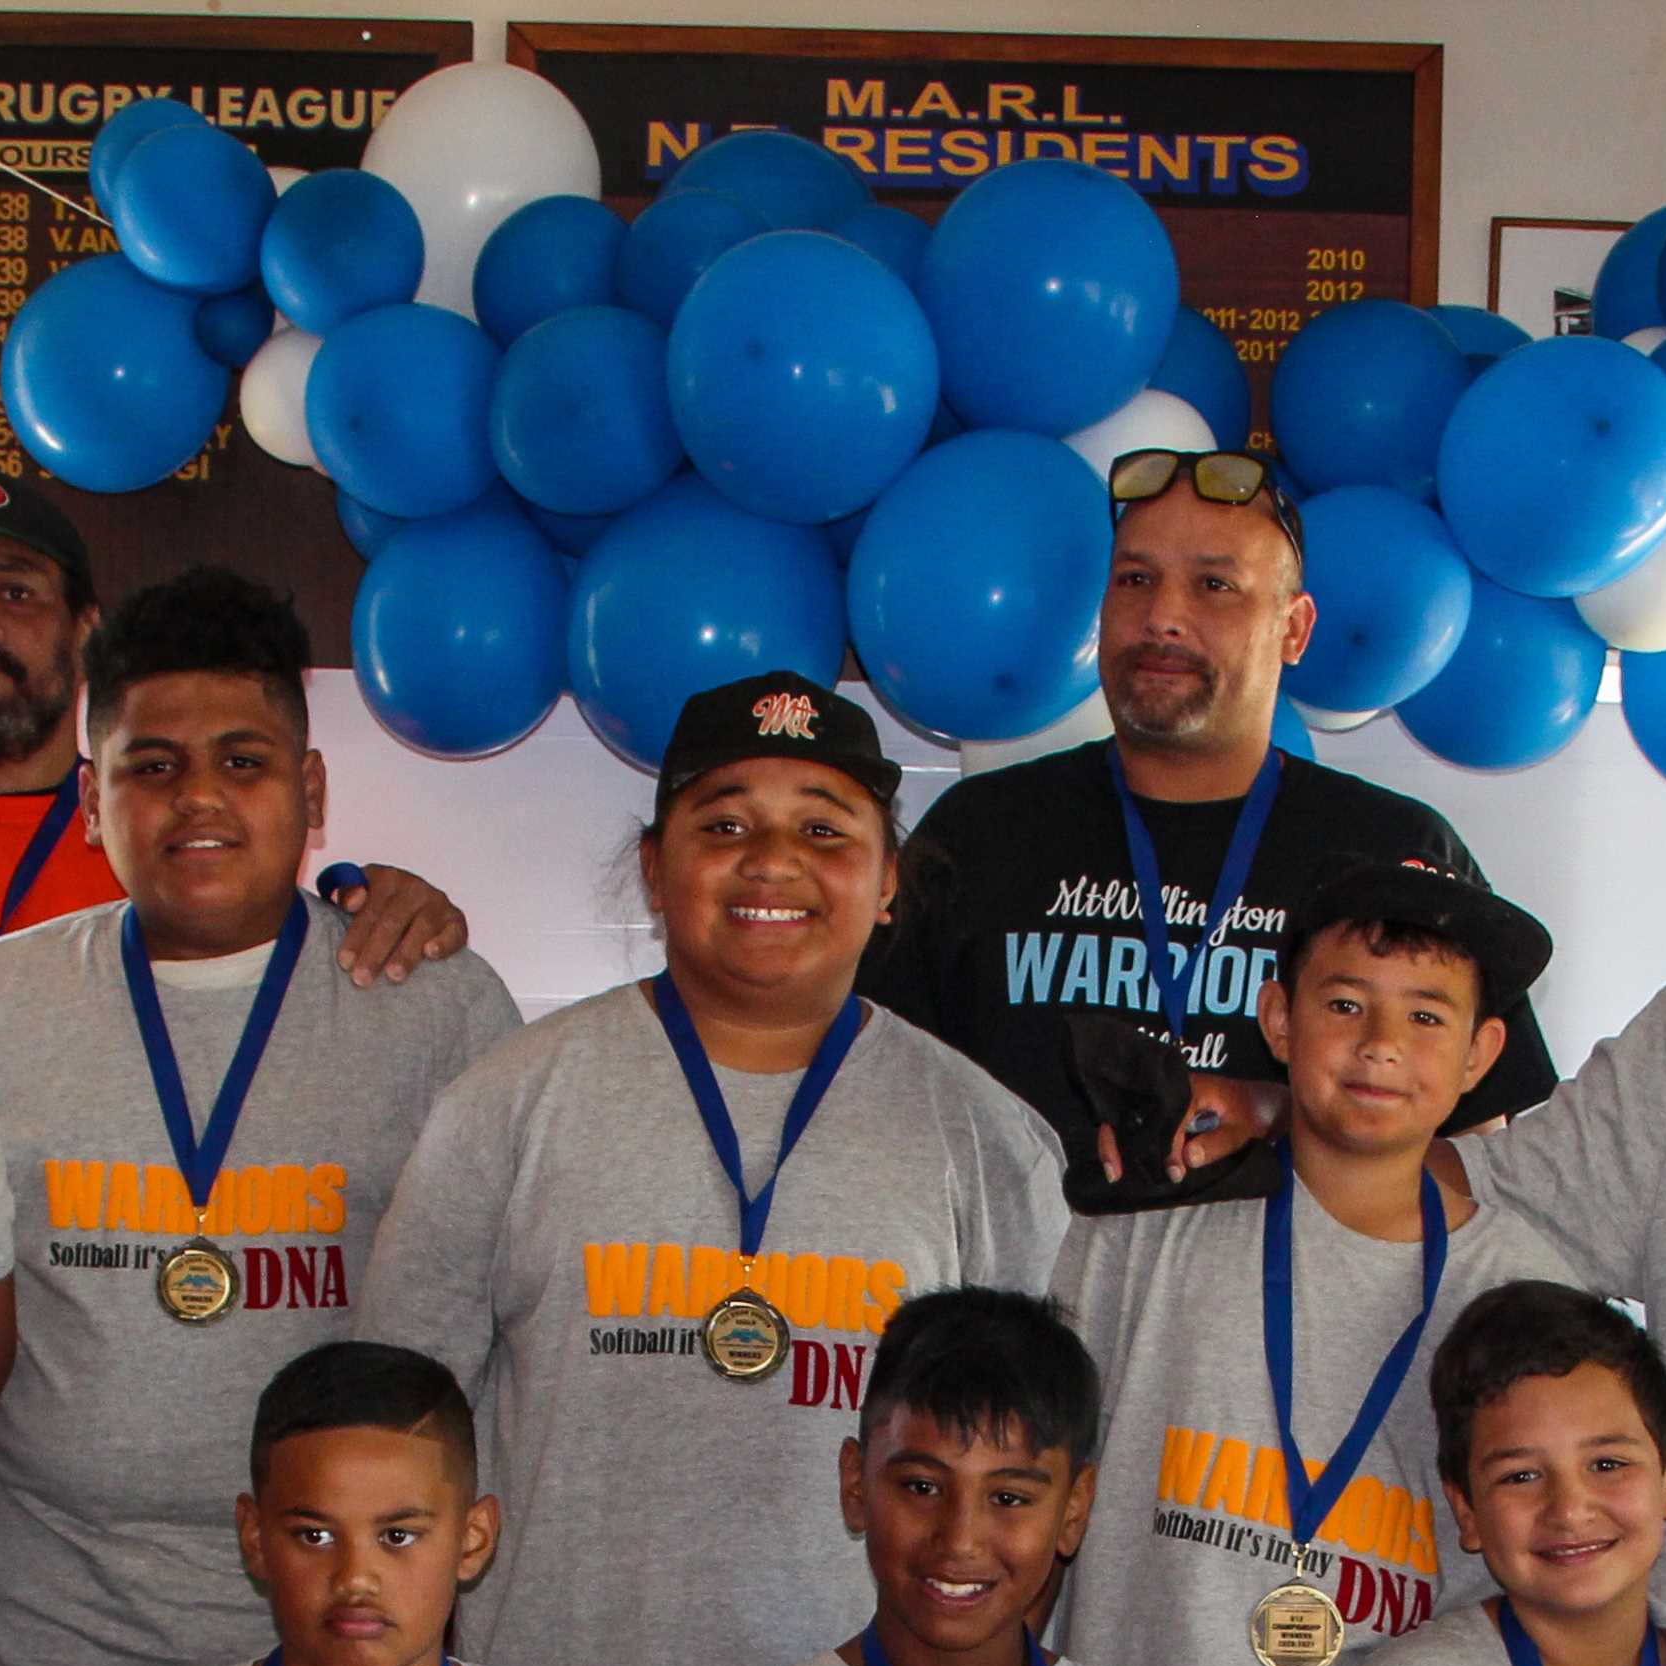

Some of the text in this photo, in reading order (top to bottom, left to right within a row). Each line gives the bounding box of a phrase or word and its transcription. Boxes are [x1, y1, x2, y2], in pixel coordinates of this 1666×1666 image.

[826, 79, 1123, 124] M.A.R.L.
[1306, 249, 1366, 271] 2010
[49, 1241, 166, 1269] Softball it's
[242, 1245, 349, 1309] DNA
[589, 1327, 675, 1355] Softball
[1224, 1524, 1262, 1557] it's
[1334, 1556, 1432, 1638] DNA
